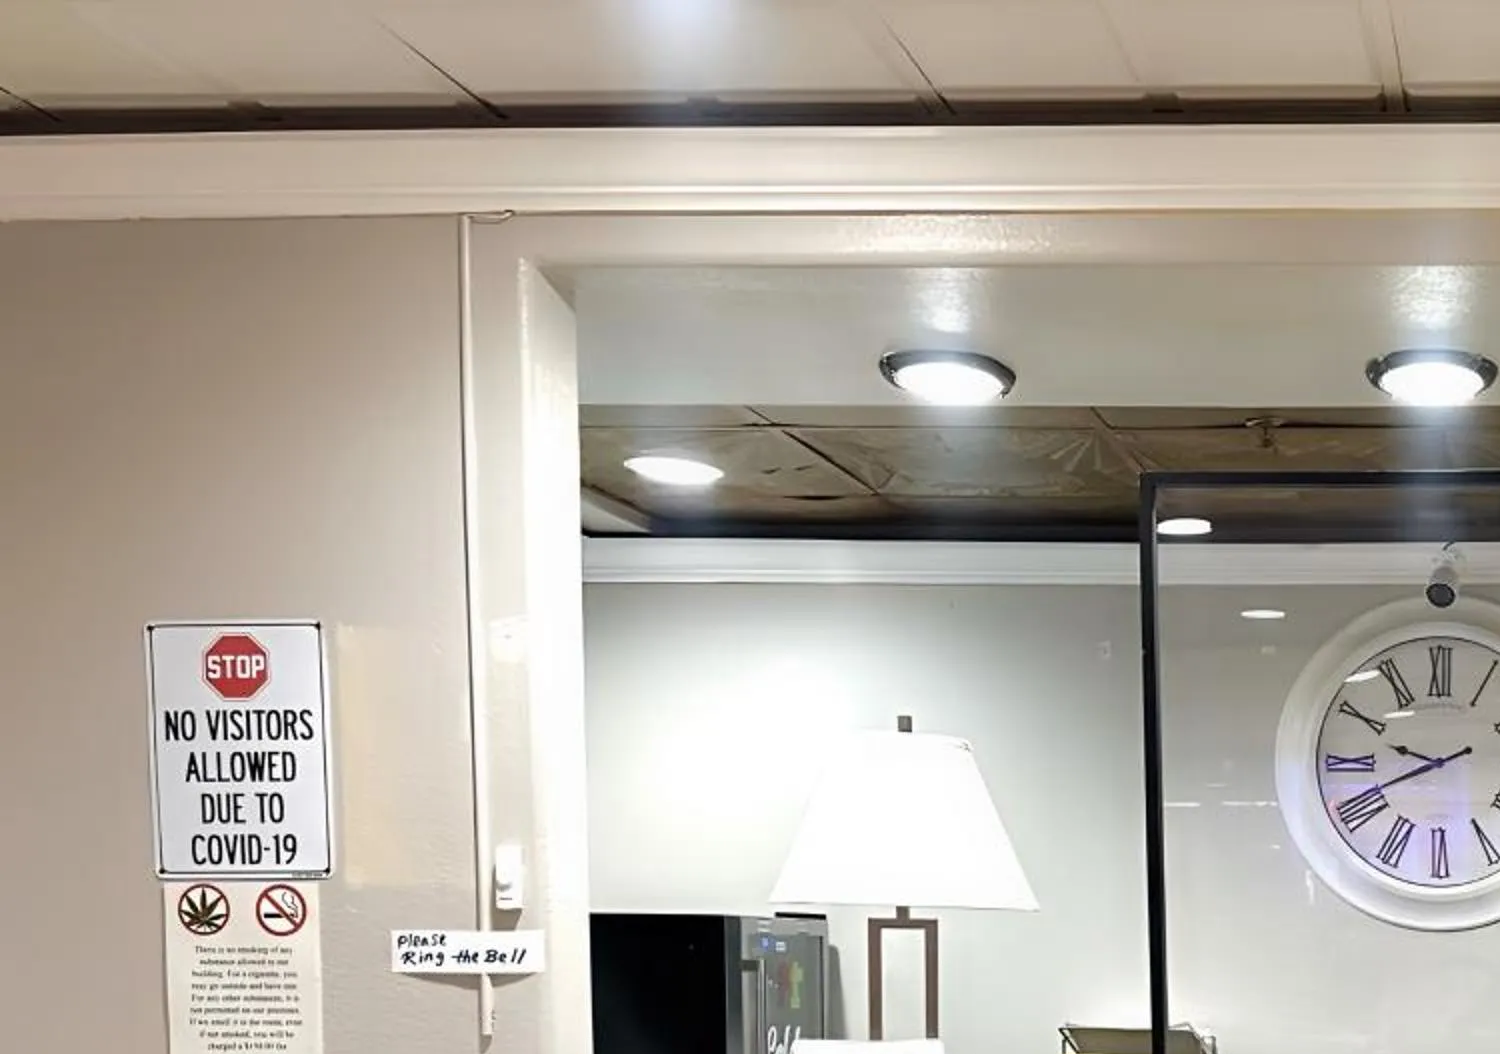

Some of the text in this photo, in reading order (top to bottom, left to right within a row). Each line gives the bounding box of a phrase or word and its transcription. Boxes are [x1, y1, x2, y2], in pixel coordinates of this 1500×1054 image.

[207, 655, 265, 679] STOP
[165, 709, 314, 741] NO VISITORS
[185, 751, 297, 783] ALLOWED
[201, 792, 285, 824] DUE TO
[191, 833, 297, 865] COVID-19
[401, 948, 526, 966] Ring the Bell
